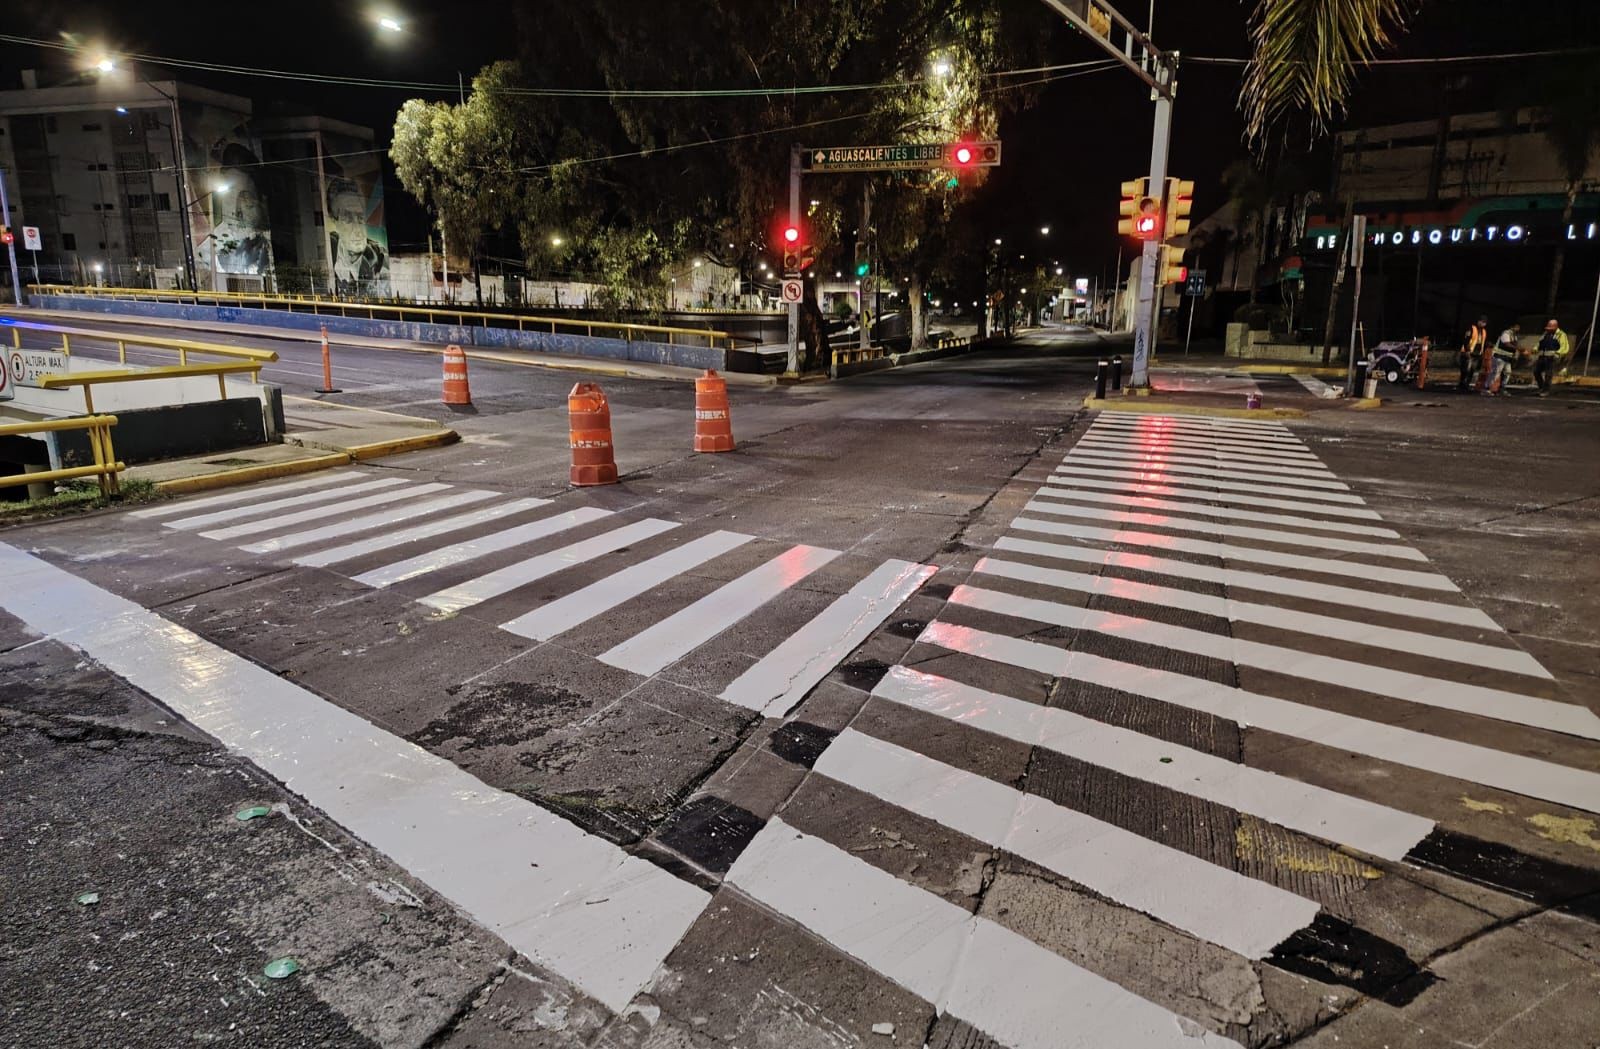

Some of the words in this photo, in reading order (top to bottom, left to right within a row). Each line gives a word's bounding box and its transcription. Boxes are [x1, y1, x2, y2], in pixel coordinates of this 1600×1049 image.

[829, 148, 907, 162] AGUASCALIENTES
[914, 146, 940, 159] LIBRE
[1374, 225, 1523, 245] MOSQUITO
[25, 356, 46, 367] ALTURA
